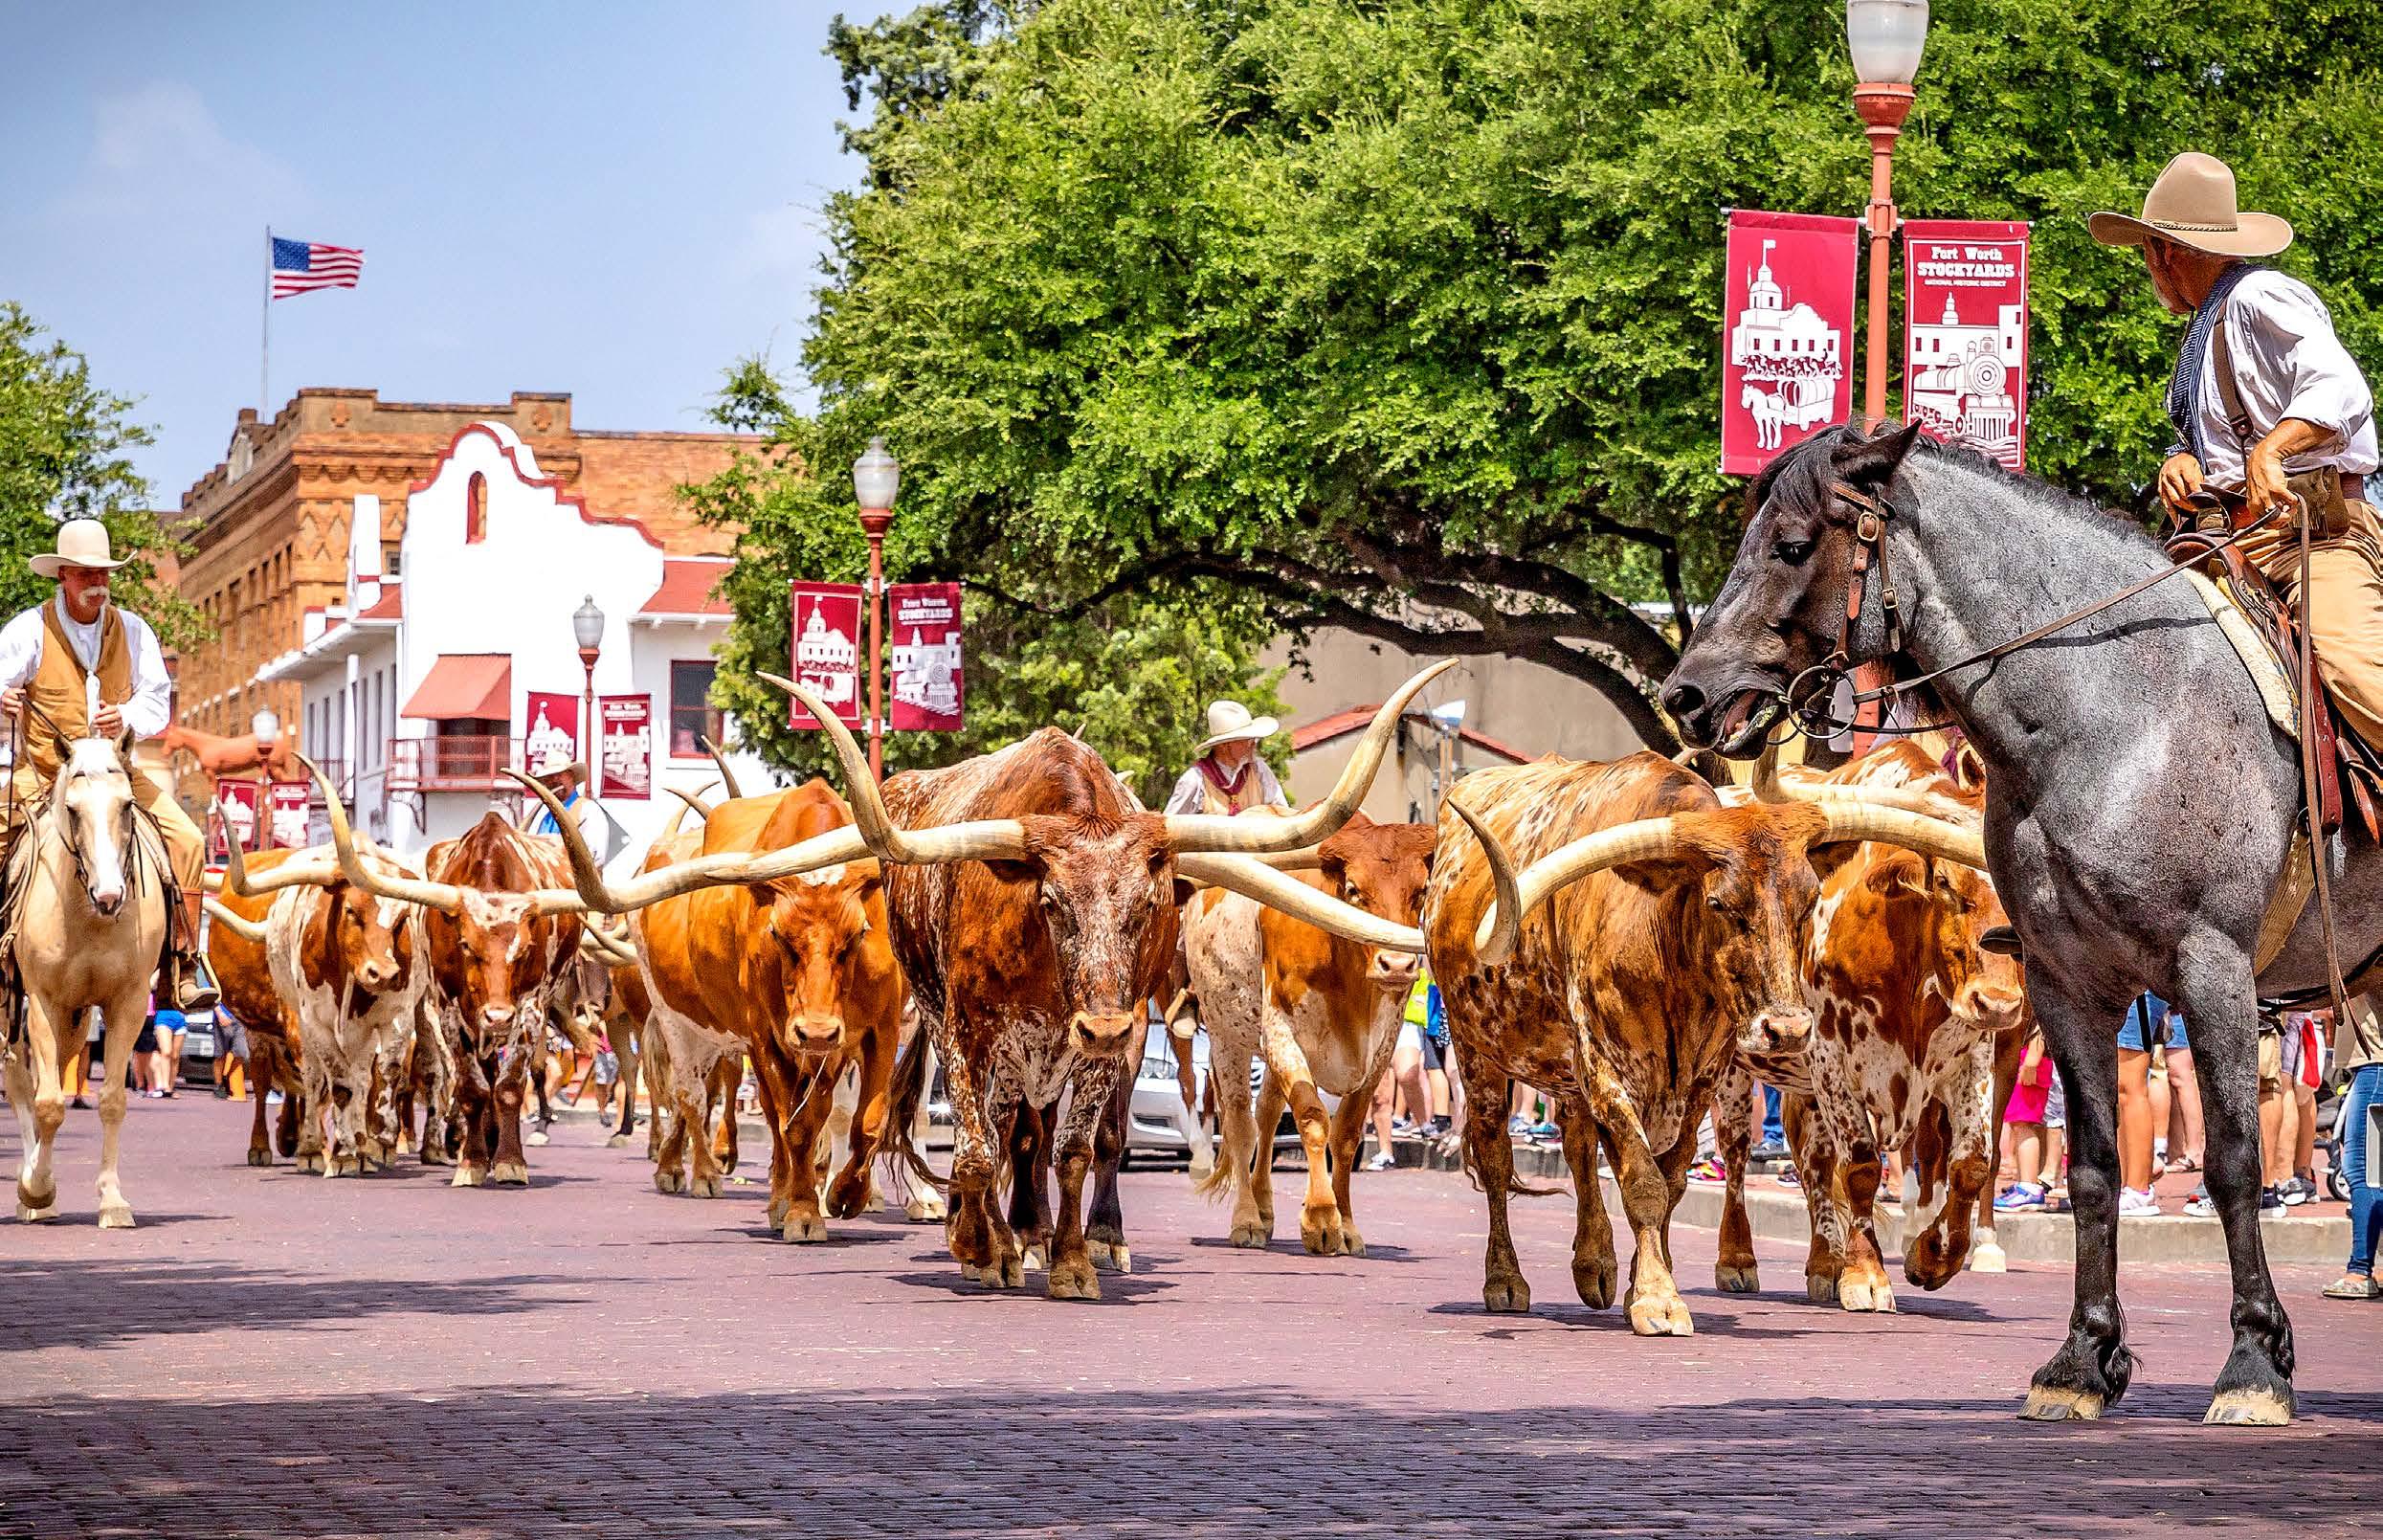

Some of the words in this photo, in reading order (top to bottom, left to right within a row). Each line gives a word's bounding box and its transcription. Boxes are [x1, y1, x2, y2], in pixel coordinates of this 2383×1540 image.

[1930, 246, 1959, 260] Fort
[1964, 246, 2003, 261] Worth
[1917, 261, 2016, 278] STOCKYARDS
